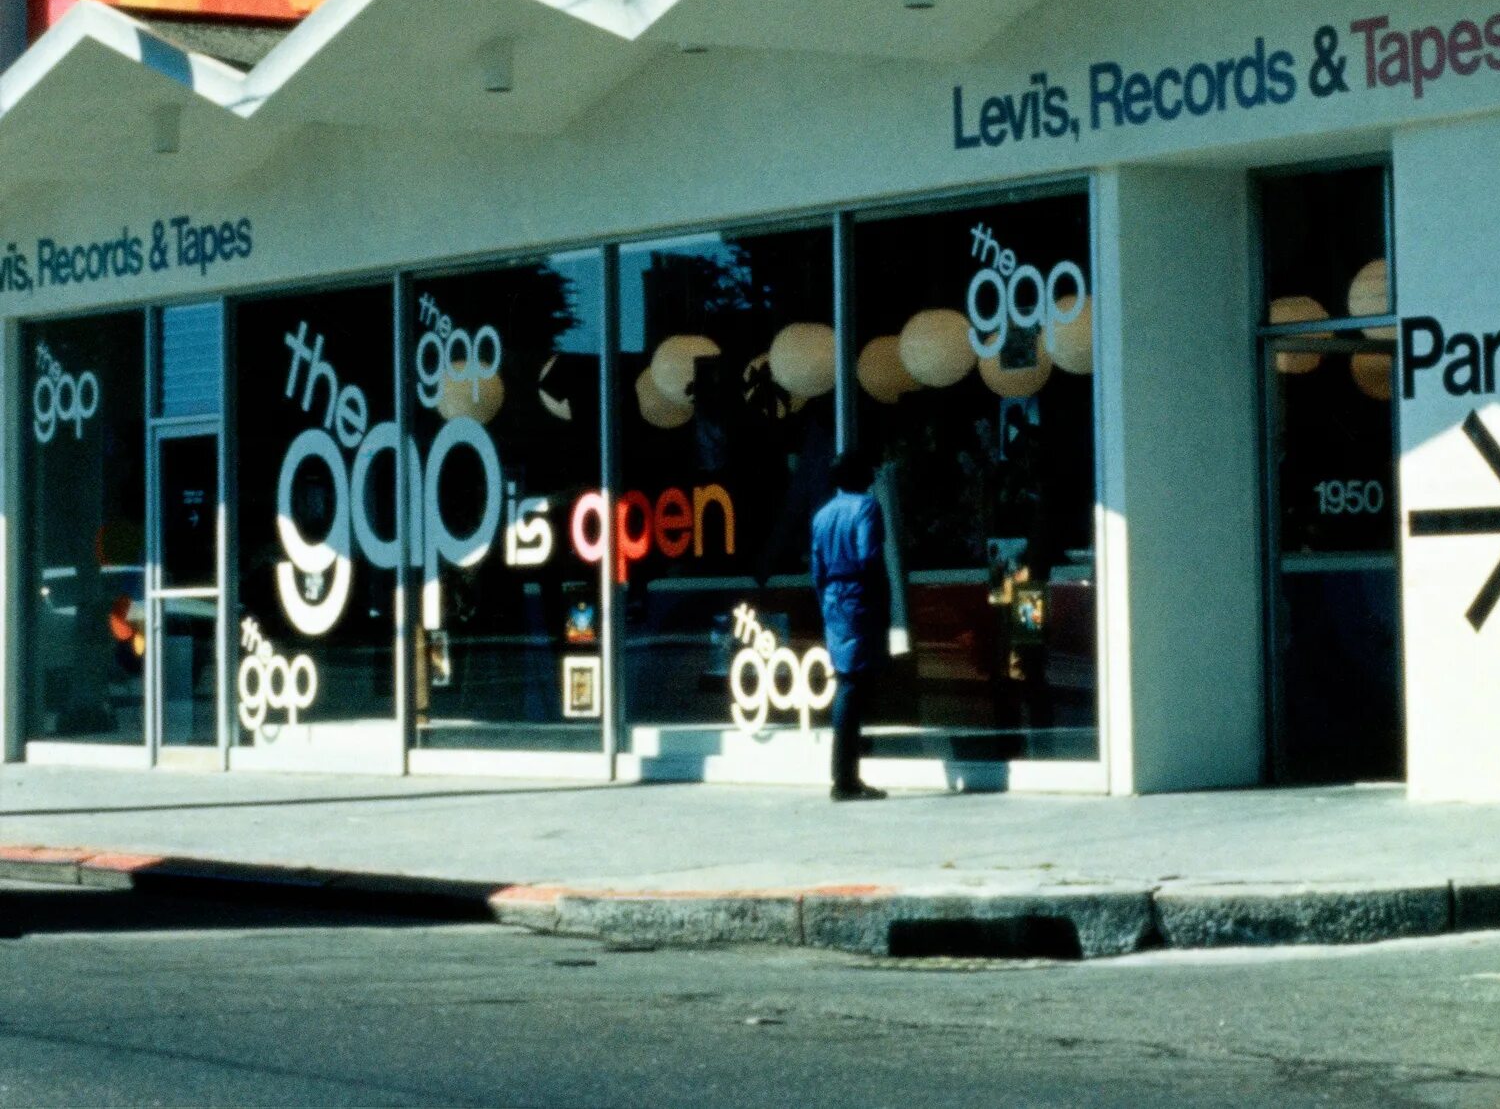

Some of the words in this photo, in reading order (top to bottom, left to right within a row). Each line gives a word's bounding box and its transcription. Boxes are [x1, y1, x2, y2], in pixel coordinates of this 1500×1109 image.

[953, 72, 1081, 151] Levi's,
[1088, 37, 1298, 130] Records
[1308, 25, 1350, 97] &
[38, 225, 144, 287] Records
[150, 219, 169, 272] &
[170, 215, 252, 276] Tapes
[970, 221, 1017, 276] the
[419, 291, 452, 339] the
[967, 260, 1086, 358] gap
[35, 340, 61, 382] the
[284, 321, 368, 448] the
[416, 325, 502, 408] gap
[33, 371, 99, 443] gap
[277, 416, 502, 635] gap
[506, 481, 552, 565] is
[570, 484, 735, 584] open
[1313, 480, 1384, 514] 1950
[240, 616, 273, 665] the
[734, 602, 776, 660] the
[238, 654, 319, 731] gap
[731, 646, 838, 735] gap
